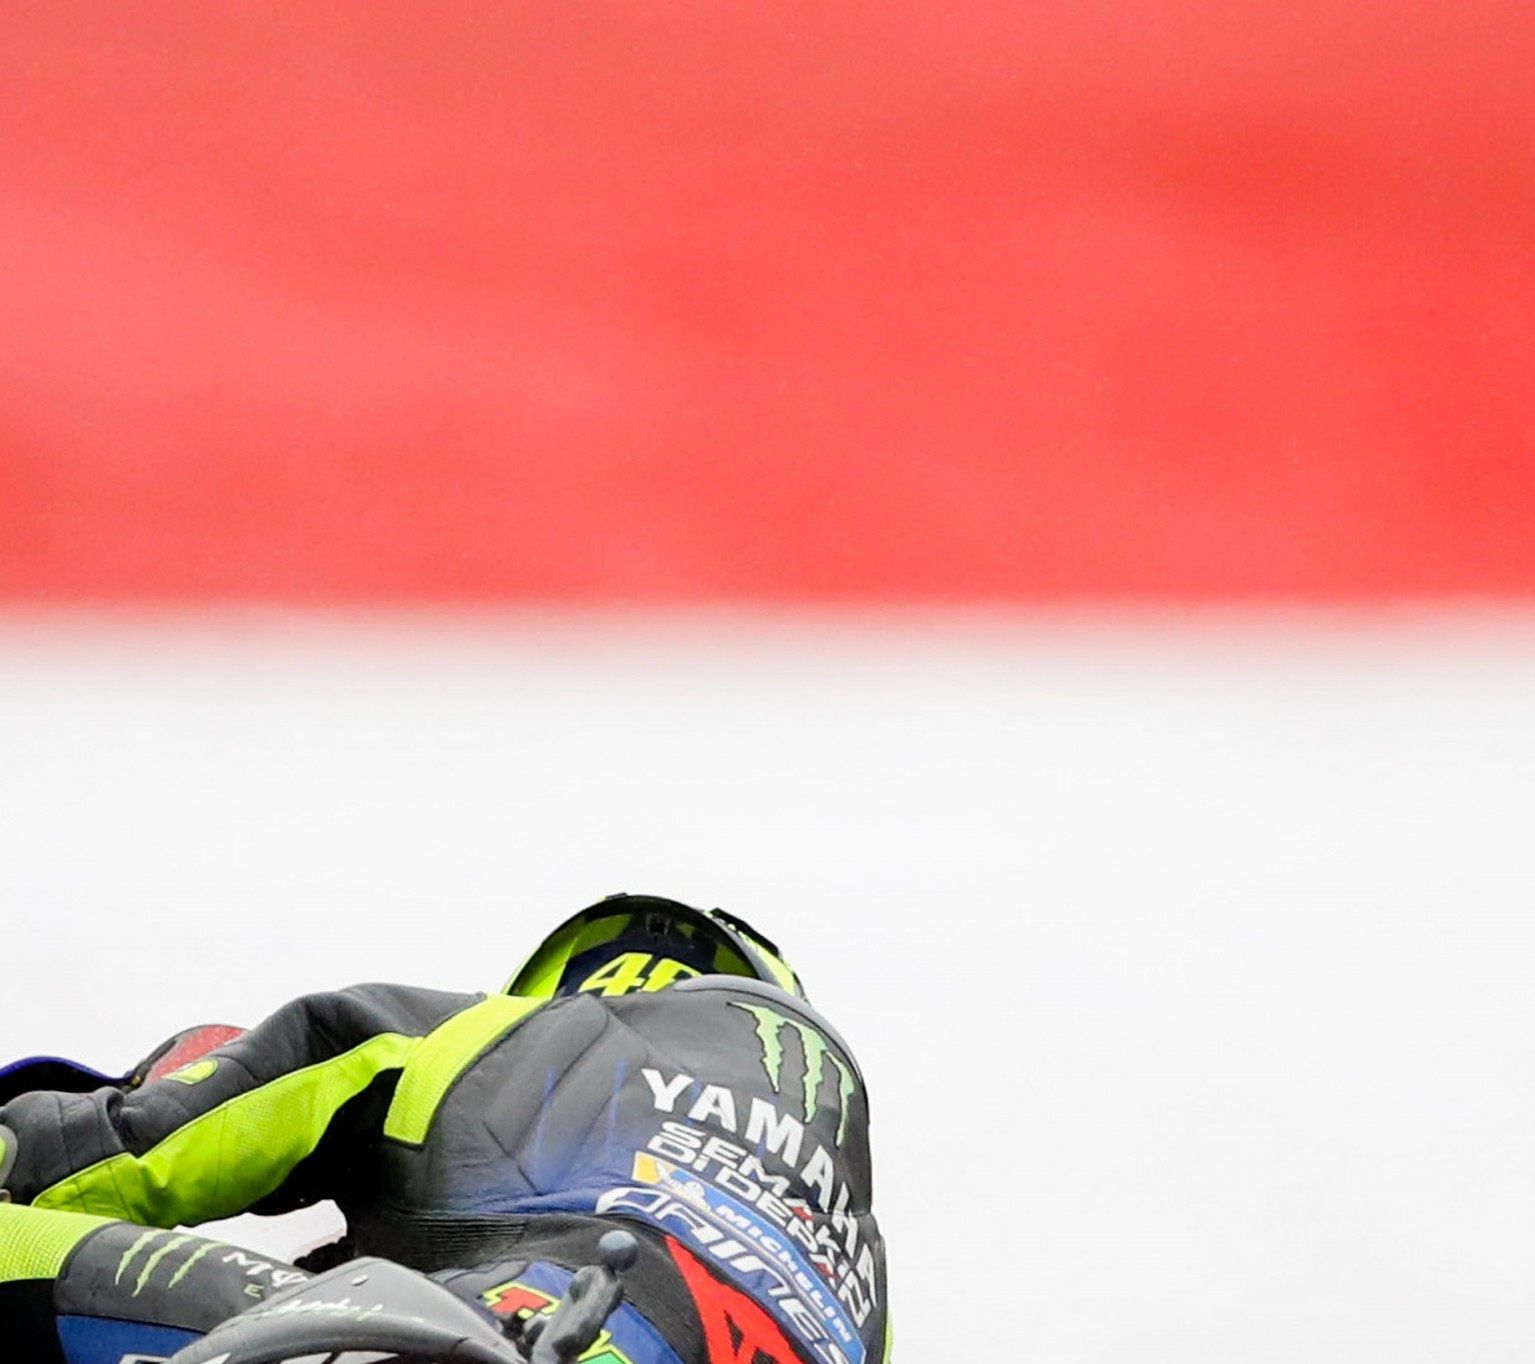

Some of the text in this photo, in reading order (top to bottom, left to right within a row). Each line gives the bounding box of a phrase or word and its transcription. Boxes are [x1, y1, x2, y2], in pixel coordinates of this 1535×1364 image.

[641, 1068, 877, 1308] YAMAHA
[647, 1135, 711, 1172] DI
[716, 1204, 851, 1342] MICHELIN
